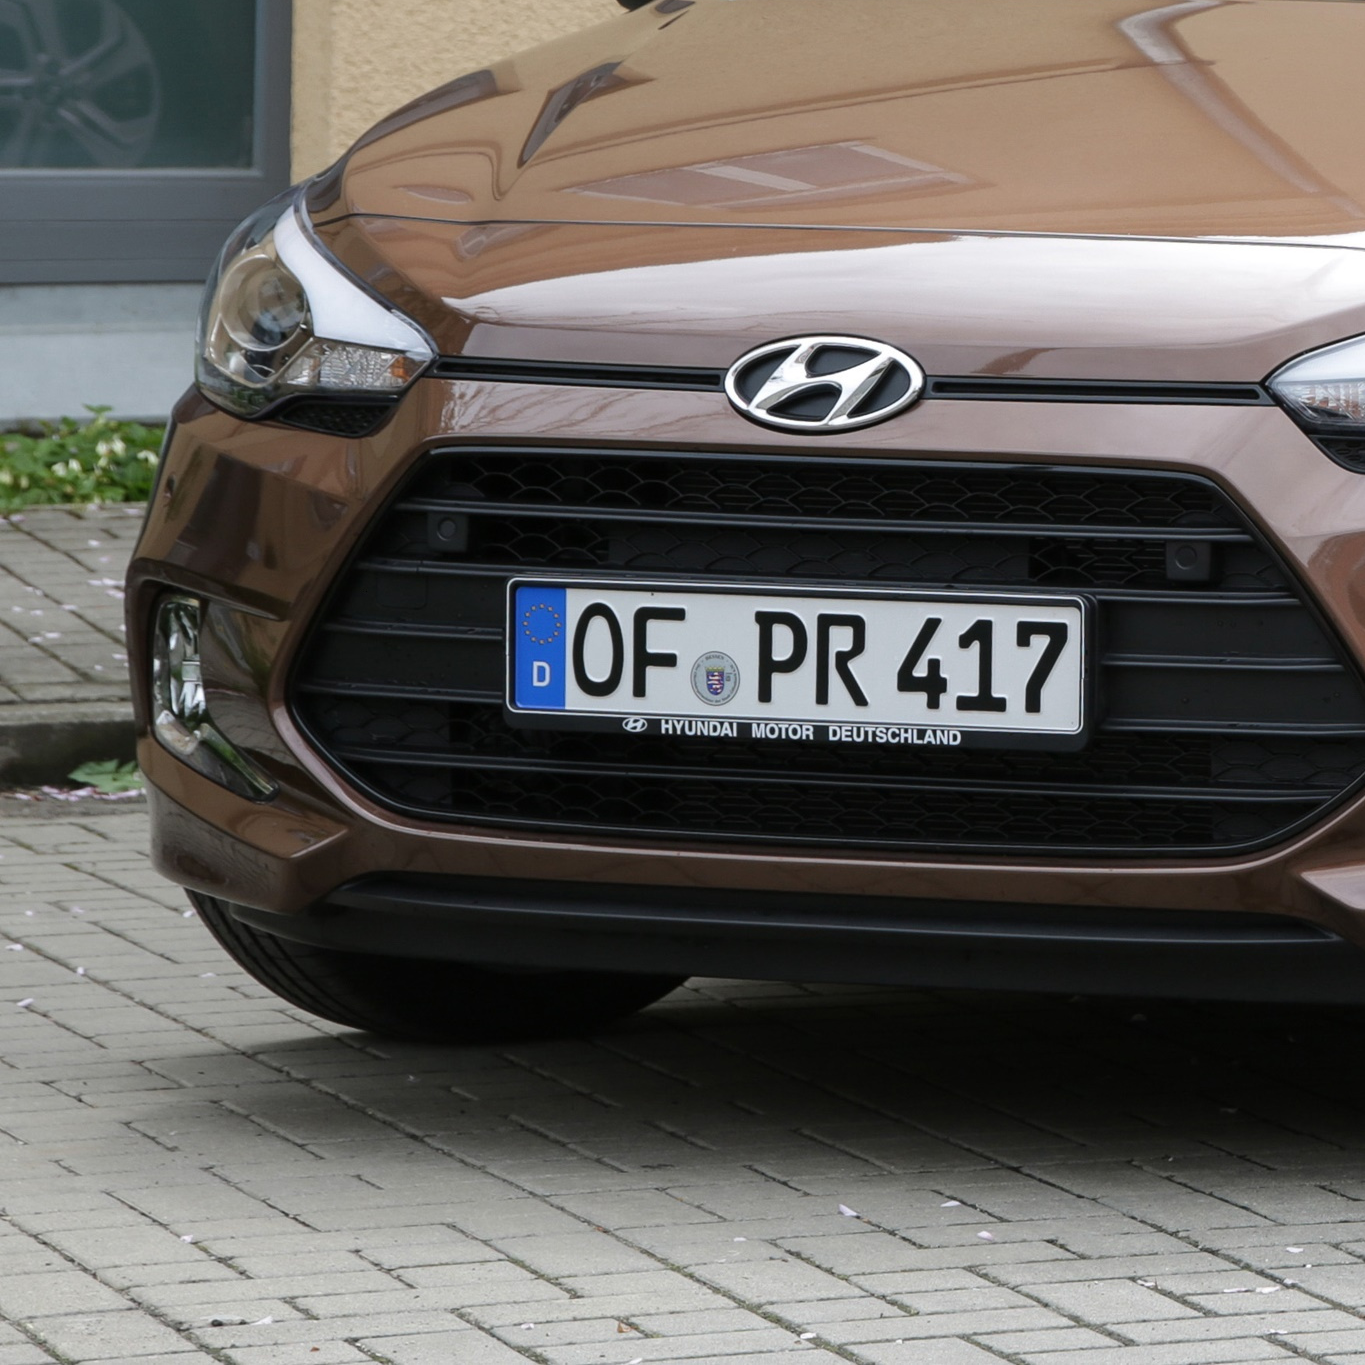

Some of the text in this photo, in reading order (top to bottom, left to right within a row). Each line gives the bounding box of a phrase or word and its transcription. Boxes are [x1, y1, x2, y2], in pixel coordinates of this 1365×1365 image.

[572, 601, 686, 698] OF
[754, 610, 869, 707] PR
[896, 617, 1069, 714] 417
[532, 660, 551, 687] D
[660, 719, 962, 746] HYUNDAI MOTOR DEUTSCHLAND
